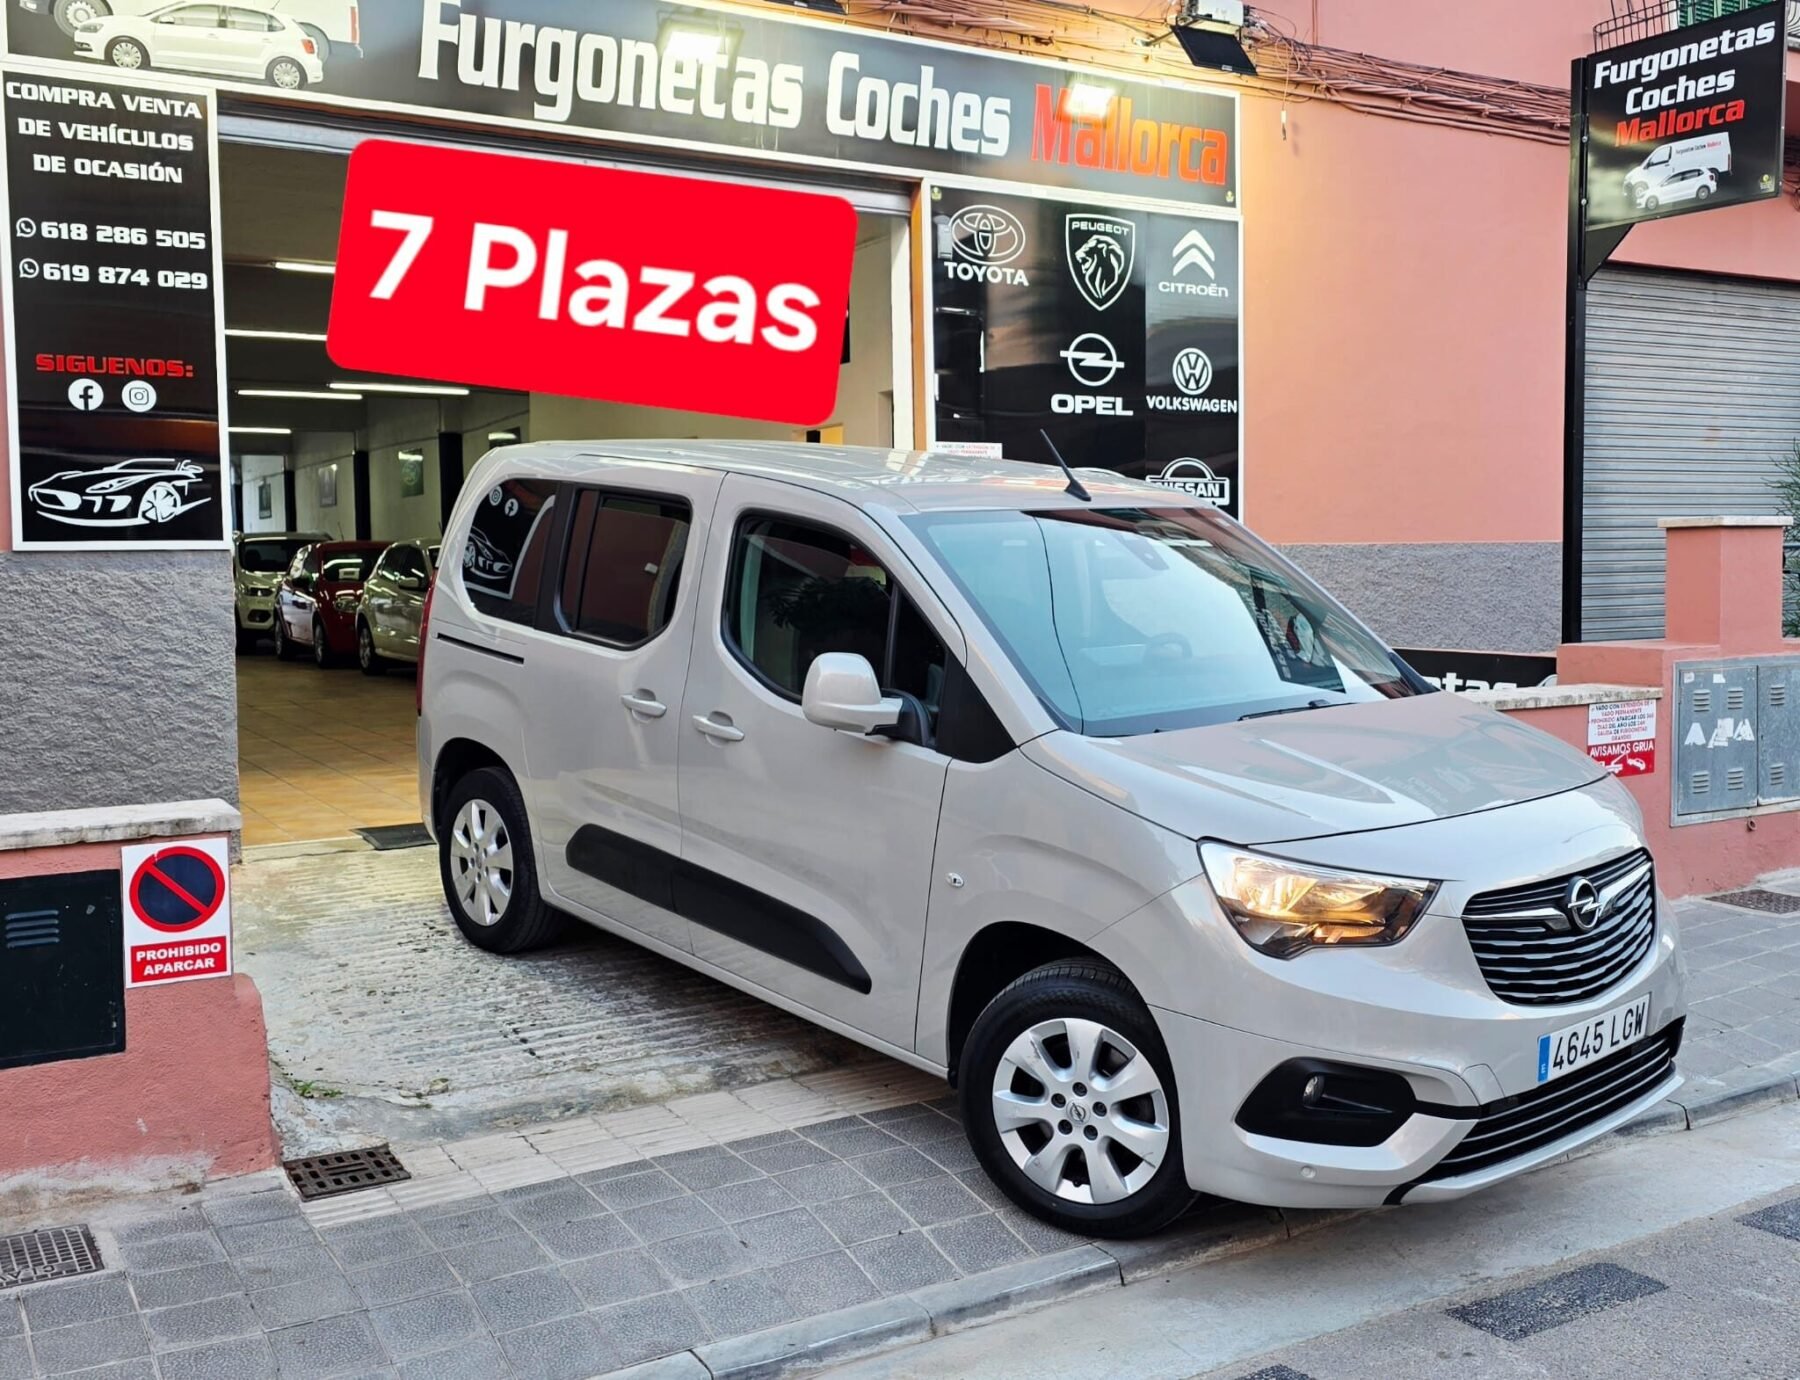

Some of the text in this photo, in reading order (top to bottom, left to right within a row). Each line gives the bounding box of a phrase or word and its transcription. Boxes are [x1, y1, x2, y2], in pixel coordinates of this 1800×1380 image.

[1594, 20, 1775, 89] Furgonetas
[6, 82, 203, 119] COMPRA VENTA
[419, 0, 1229, 186] Furgonetas Coches Mallorca
[1625, 69, 1736, 115] Coches
[18, 117, 194, 151] DE VEHÍCULOS
[1615, 99, 1745, 147] Mallorca
[33, 153, 183, 183] DE OCASIÓN
[41, 221, 206, 250] 618 286 505
[1071, 220, 1131, 236] PEUGEOT
[43, 263, 208, 290] 619 874 029
[944, 261, 1029, 286] TOYOTA
[36, 353, 194, 378] SIGUENOS:
[1051, 393, 1134, 416] OPEL
[1146, 395, 1238, 413] VOLKSWAGEN
[1590, 740, 1655, 757] AVISAMOS GRUA
[135, 942, 222, 962] PROHIBIDO
[143, 957, 216, 976] APARCAR
[1553, 1020, 1605, 1070] 4645
[1610, 1001, 1646, 1049] LGW
